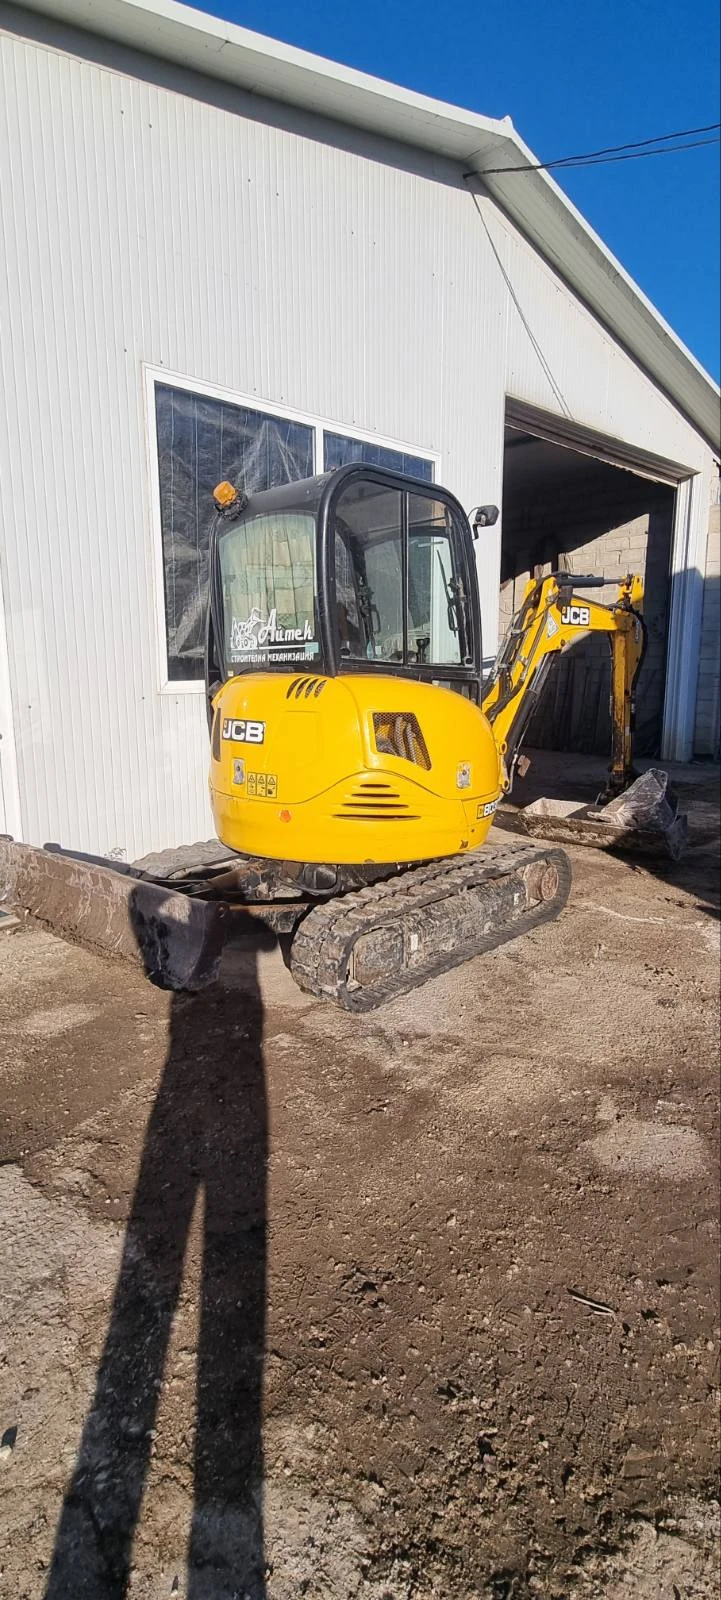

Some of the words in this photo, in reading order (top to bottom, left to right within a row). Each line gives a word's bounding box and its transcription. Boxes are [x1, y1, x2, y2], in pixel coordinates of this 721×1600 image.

[561, 606, 589, 625] JCB
[231, 653, 266, 664] СТРОИТЕЛНА
[267, 651, 315, 663] МЕХАНИЗАЦИЯ
[222, 719, 265, 743] JCB
